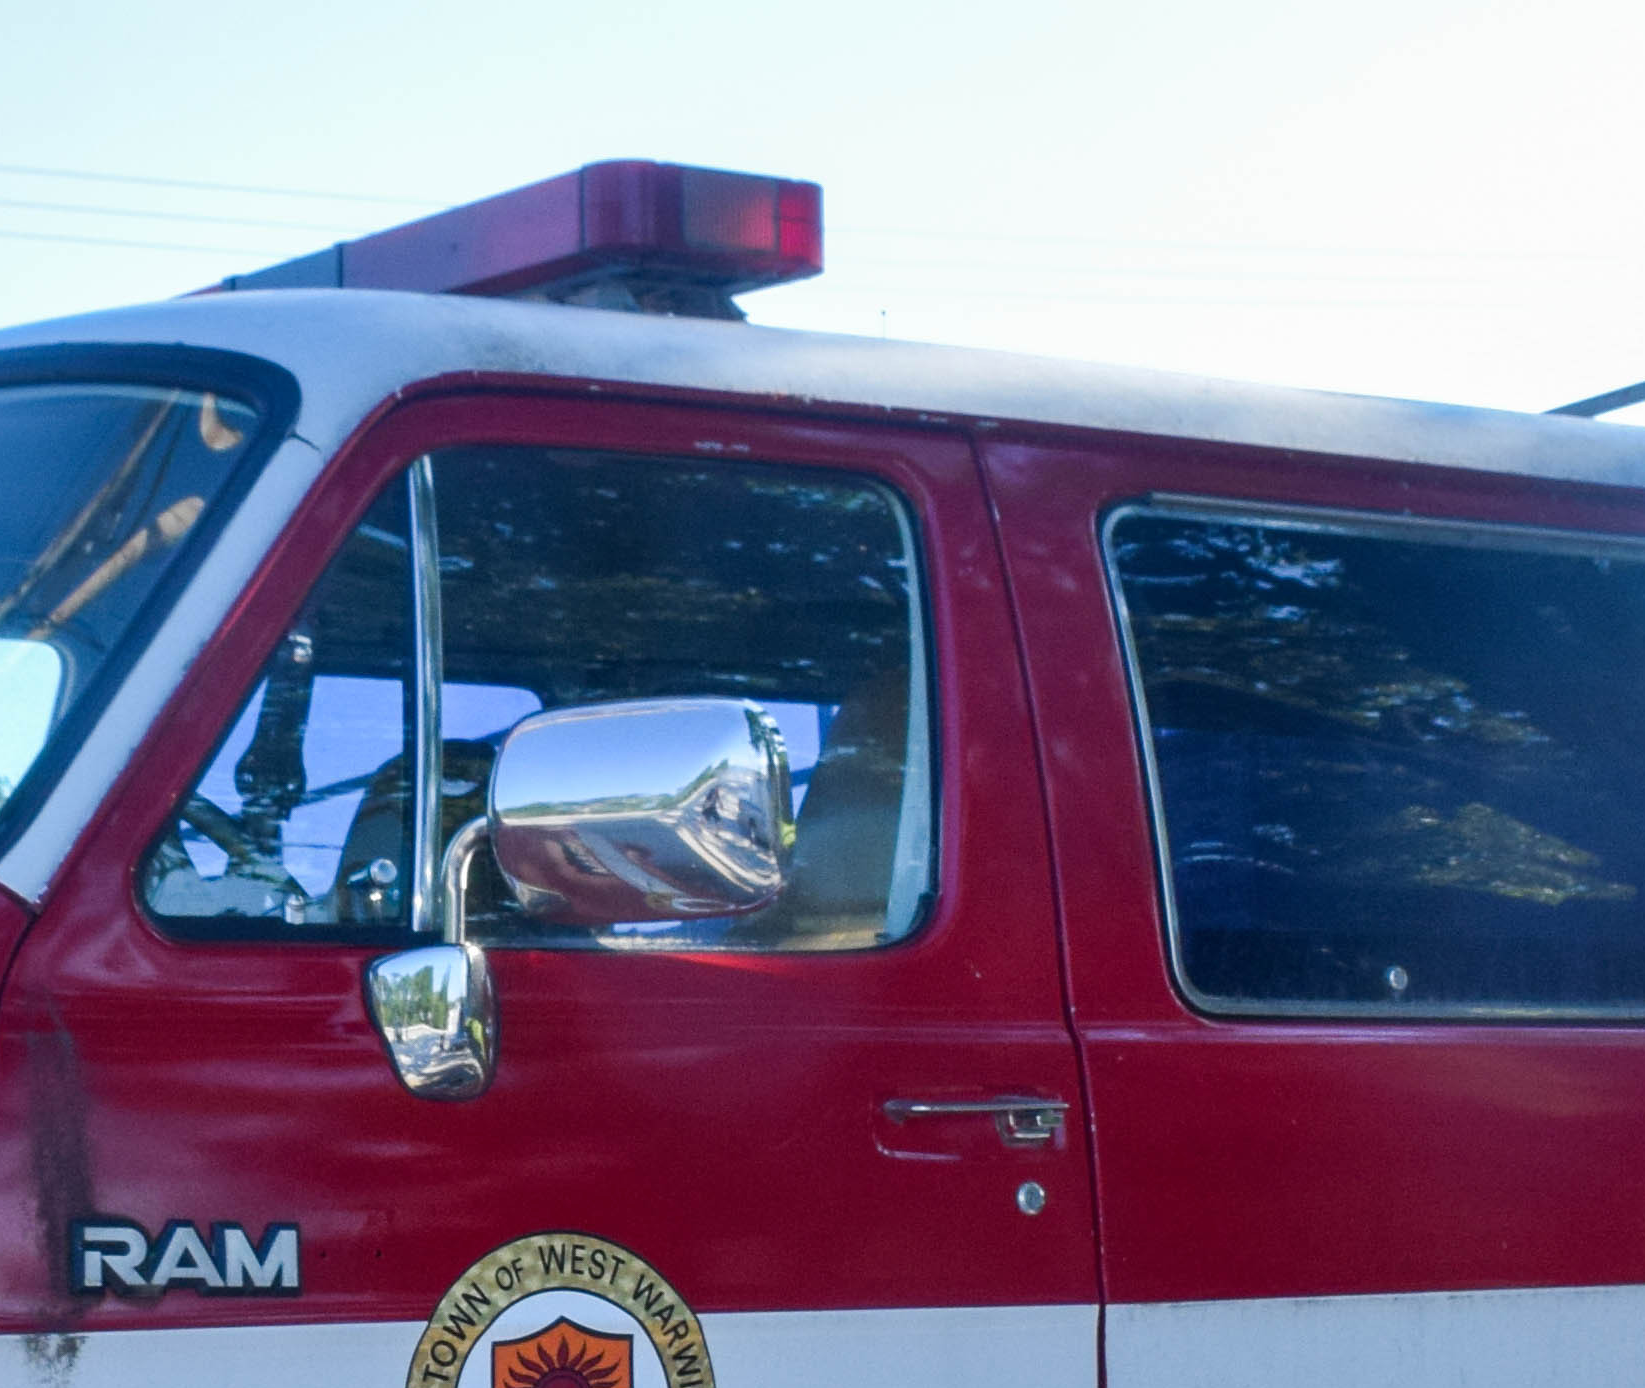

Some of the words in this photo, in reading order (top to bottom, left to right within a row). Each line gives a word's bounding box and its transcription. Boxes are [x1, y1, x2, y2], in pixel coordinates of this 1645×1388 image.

[82, 1225, 299, 1288] RAM
[422, 1282, 491, 1384] TOWN
[494, 1257, 524, 1292] OF
[538, 1243, 625, 1285] WEST
